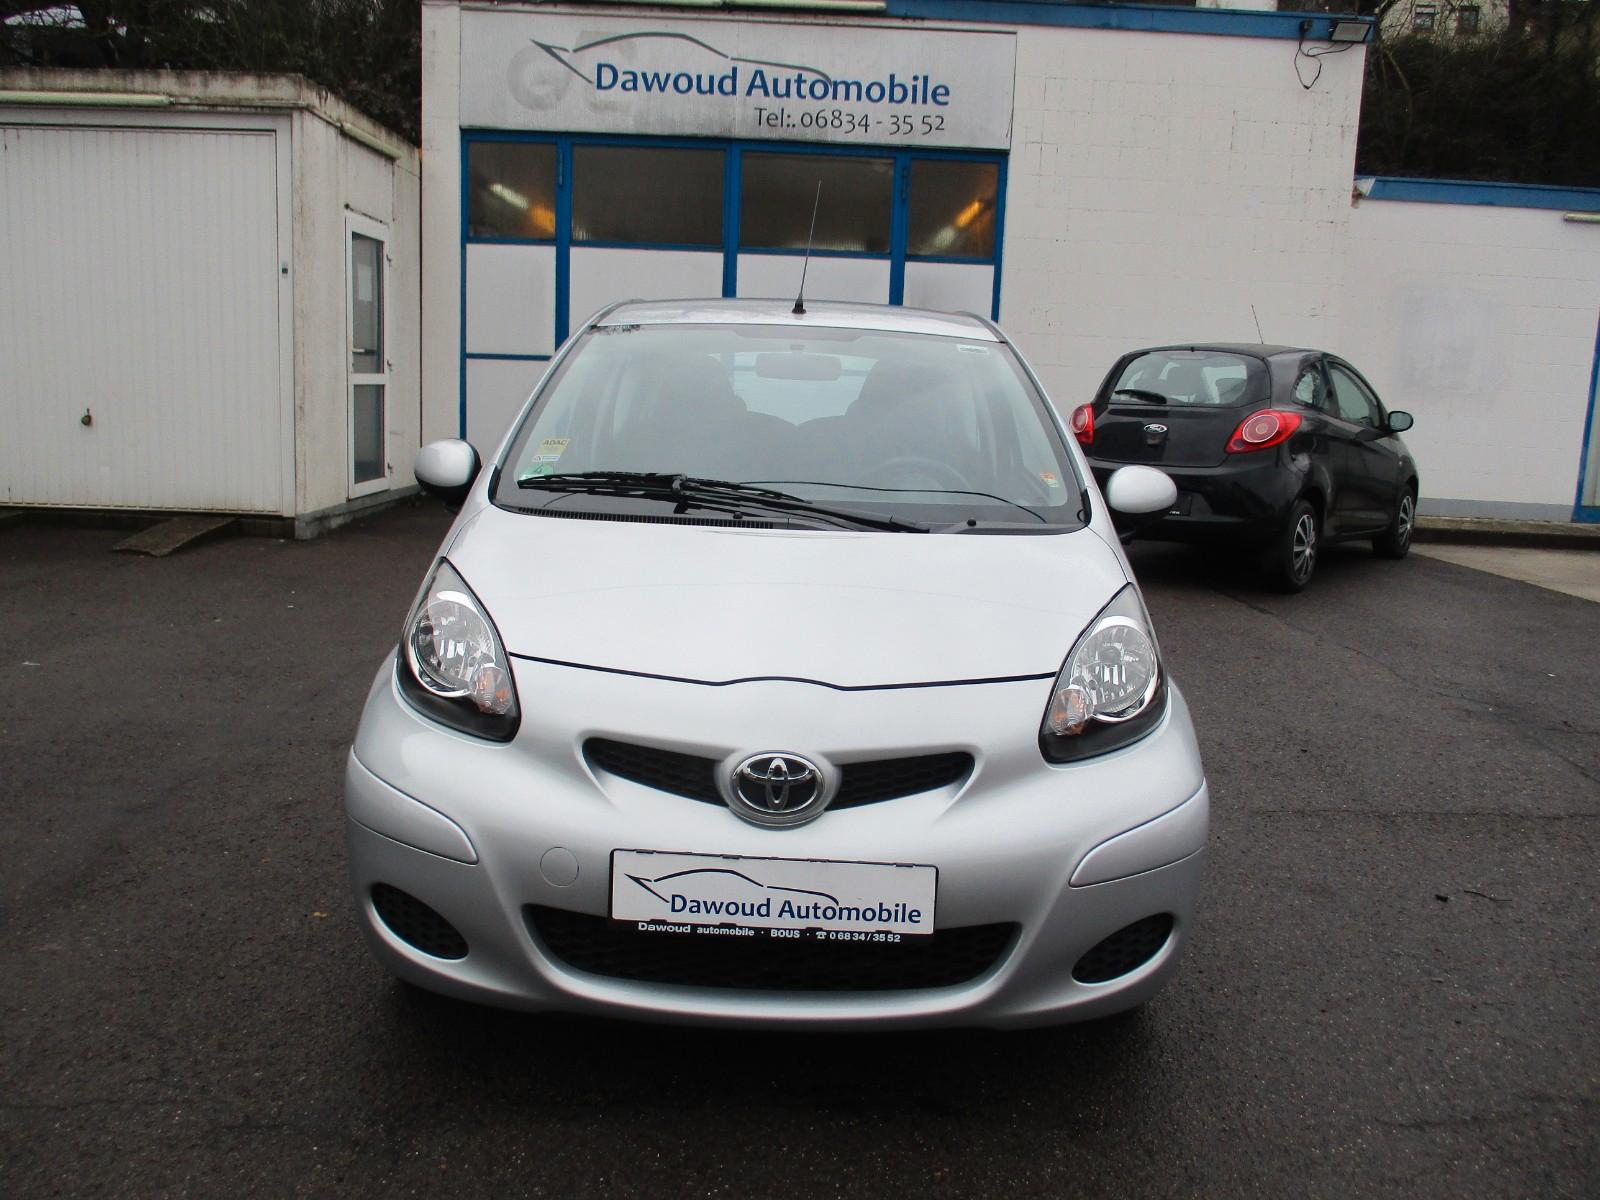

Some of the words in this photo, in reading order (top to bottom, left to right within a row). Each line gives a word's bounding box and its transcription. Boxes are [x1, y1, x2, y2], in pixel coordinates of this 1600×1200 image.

[596, 63, 737, 96] Dawoud
[745, 69, 950, 106] Automobile
[670, 893, 771, 918] Dawoud
[777, 898, 921, 924] Automobile
[638, 921, 691, 933] Dawoud
[696, 925, 755, 936] automobile
[770, 928, 800, 938] BOUS
